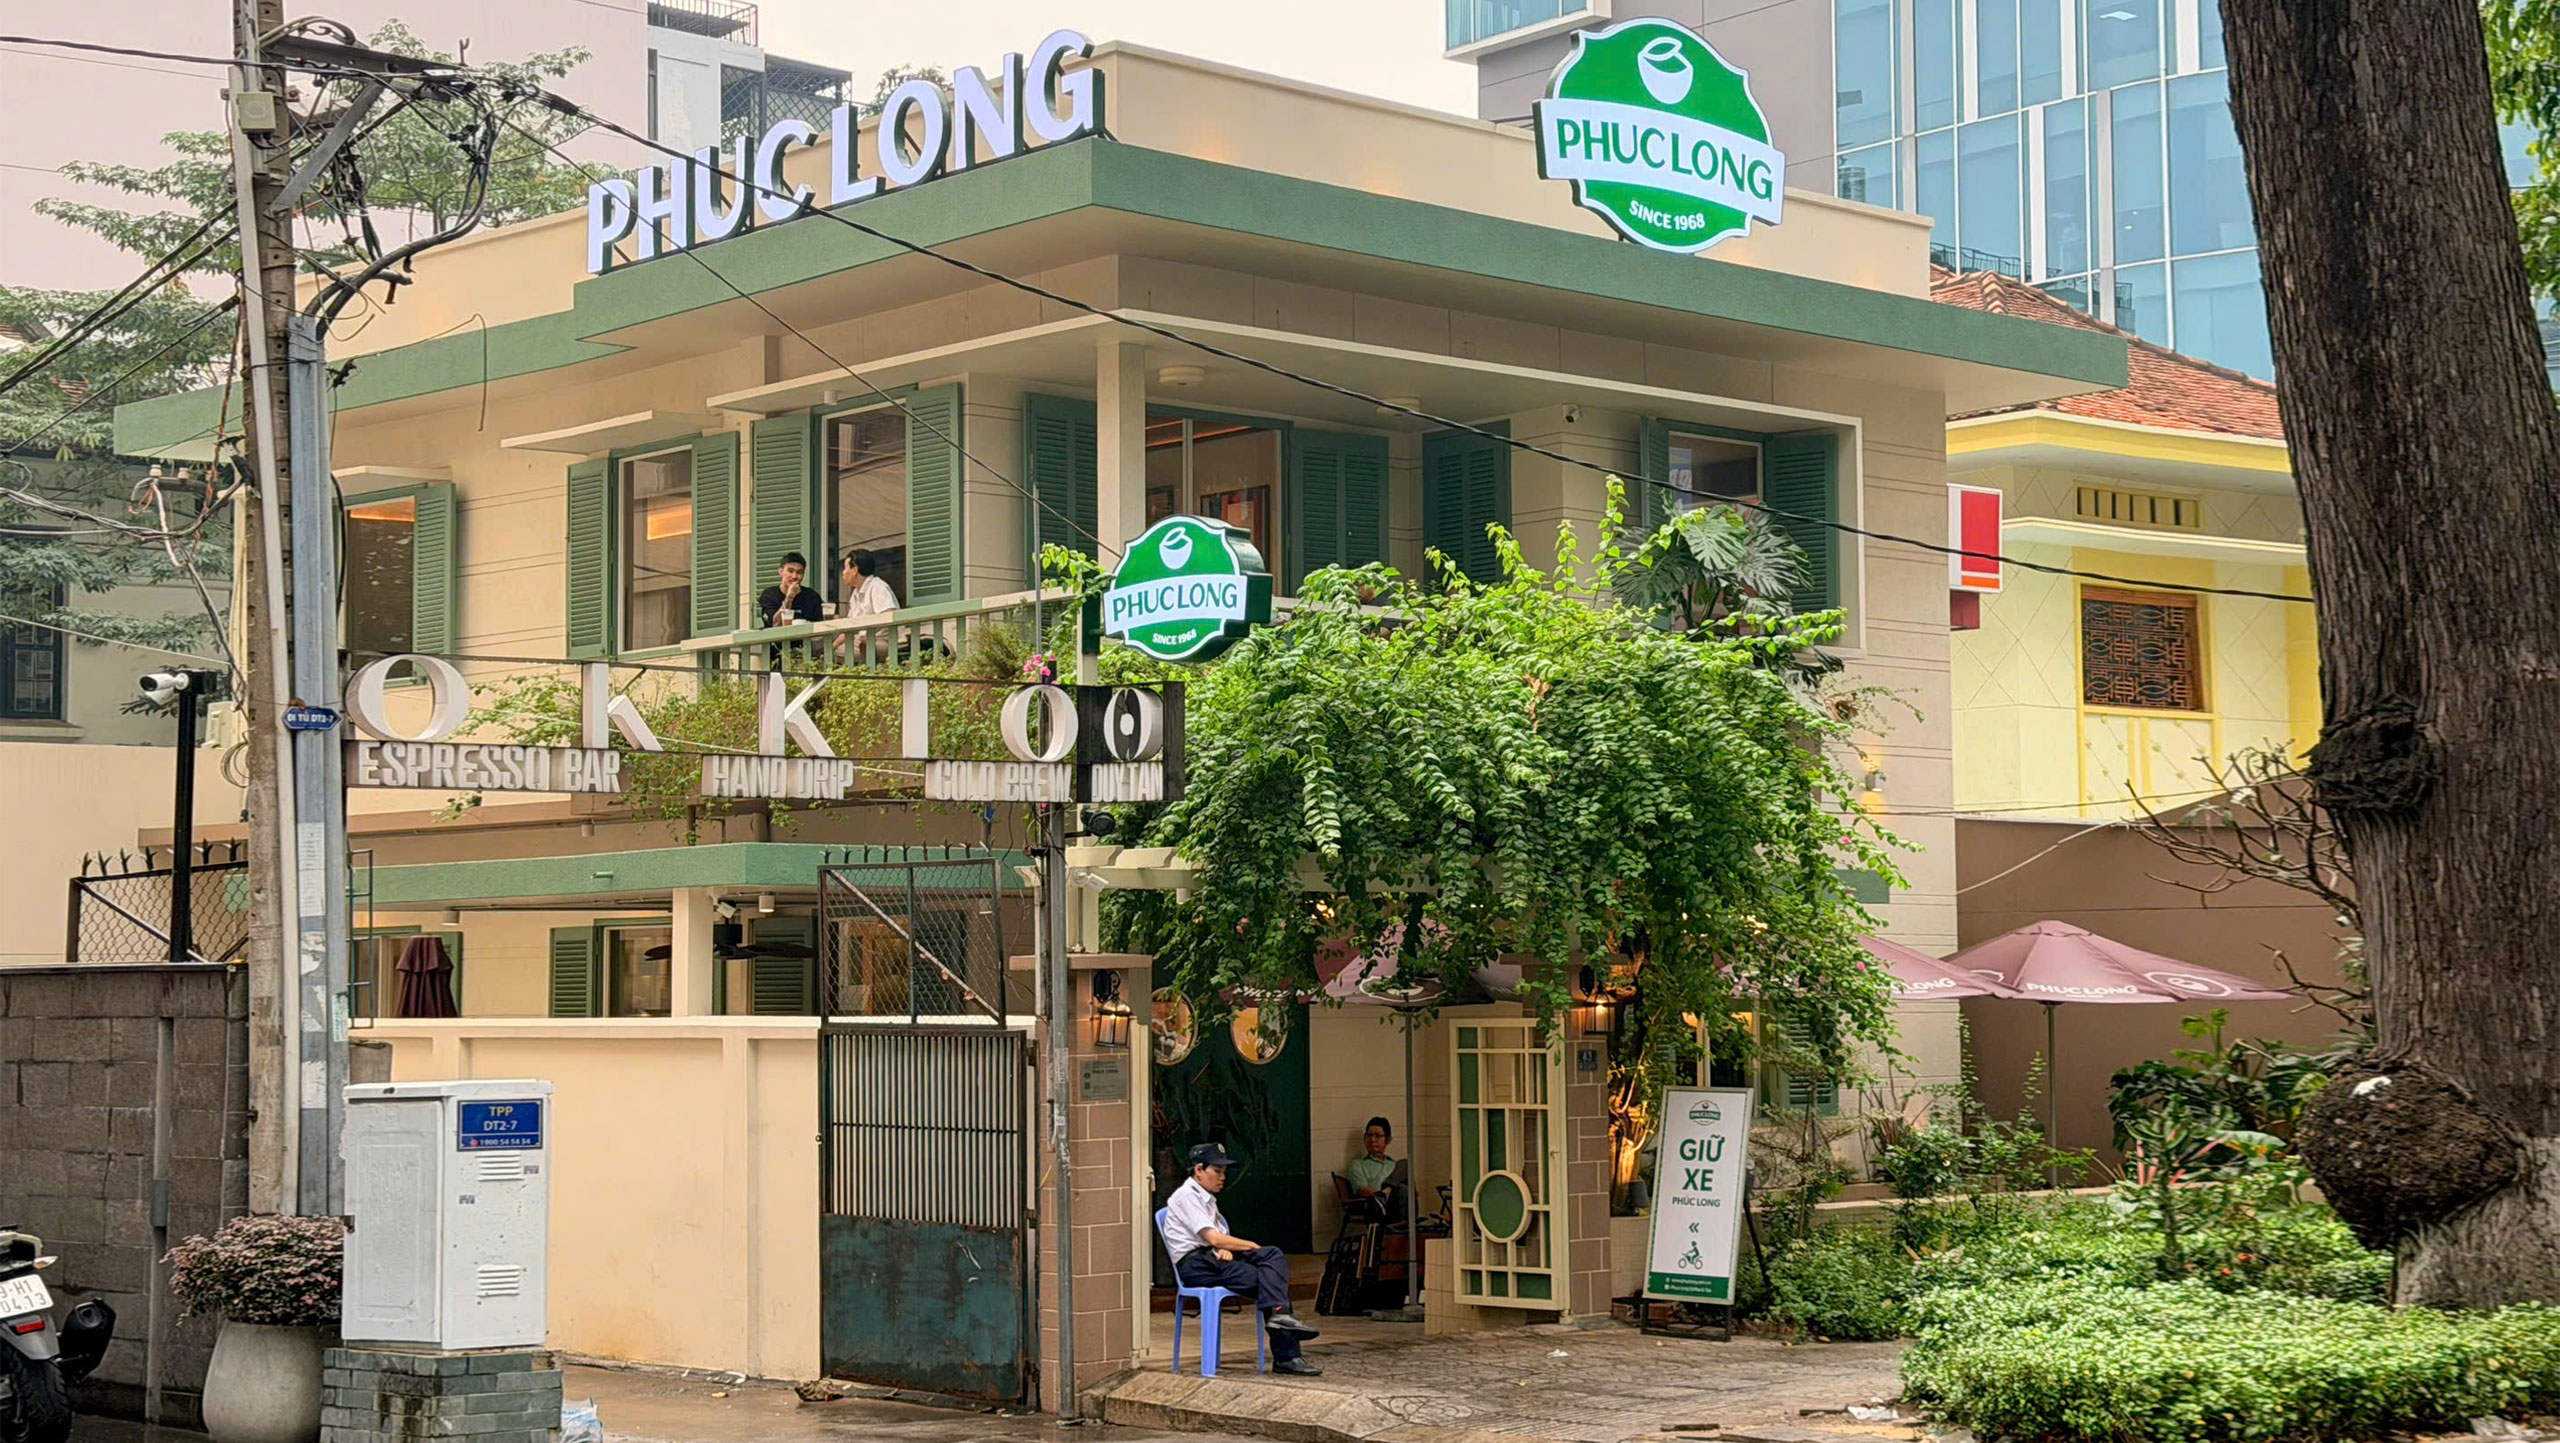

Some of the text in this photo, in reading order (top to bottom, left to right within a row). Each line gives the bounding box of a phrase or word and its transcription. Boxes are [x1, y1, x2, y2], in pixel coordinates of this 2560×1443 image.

[1629, 200, 1706, 231] SINCE 1968
[1152, 628, 1198, 645] SINCE 1968
[357, 740, 622, 793] ESPRESSO BAR
[712, 754, 854, 800] HAND DRIP
[935, 760, 1073, 802] COLD BREW
[488, 1106, 514, 1117] TPP
[483, 1120, 518, 1132] DT2-7
[1679, 1134, 1726, 1163] GIỮ
[1682, 1168, 1714, 1192] XE
[1697, 1198, 1721, 1208] LONG
